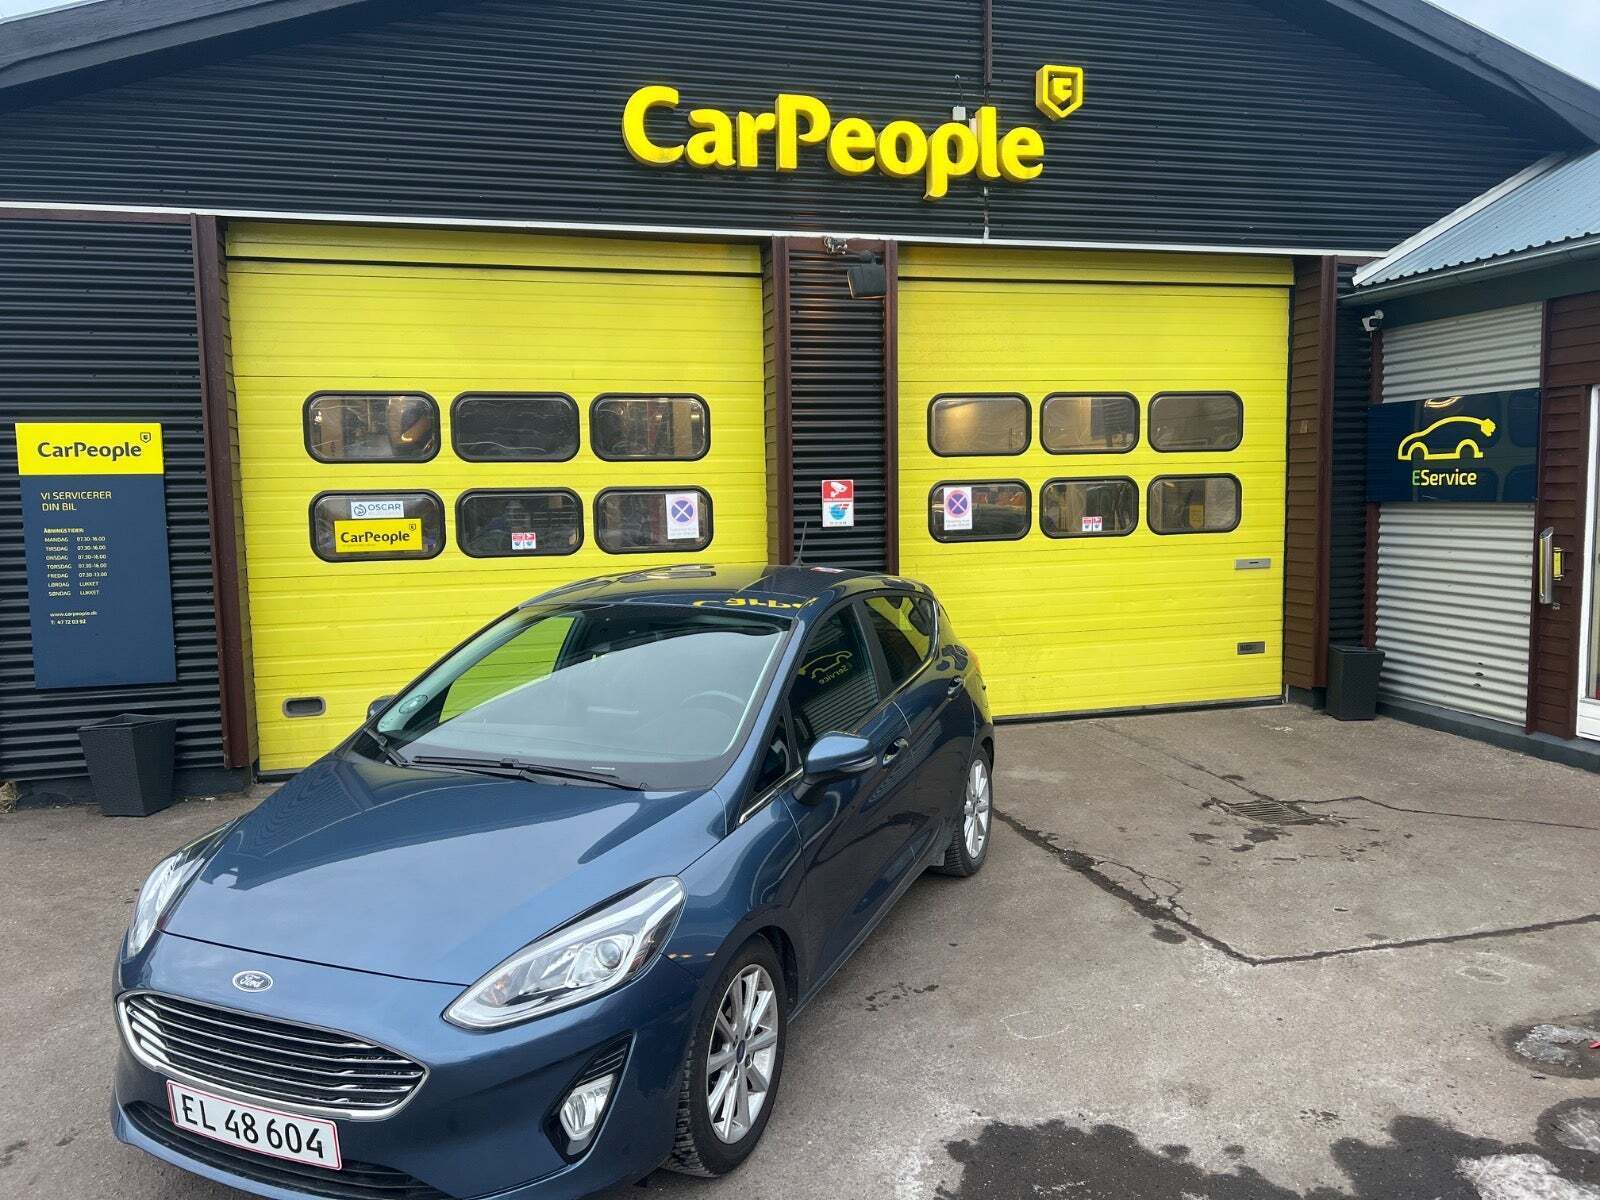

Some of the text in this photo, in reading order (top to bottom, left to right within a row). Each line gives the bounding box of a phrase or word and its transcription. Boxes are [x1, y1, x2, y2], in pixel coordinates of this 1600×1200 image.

[622, 85, 1045, 199] CarPeople
[37, 442, 142, 461] CarPeople
[1411, 468, 1477, 486] EService
[40, 491, 112, 500] VI SERVICERER
[42, 502, 77, 511] DIN BIL
[367, 503, 401, 511] OSCAR
[340, 531, 410, 544] CarPeople
[180, 1093, 324, 1160] EL 48 604
